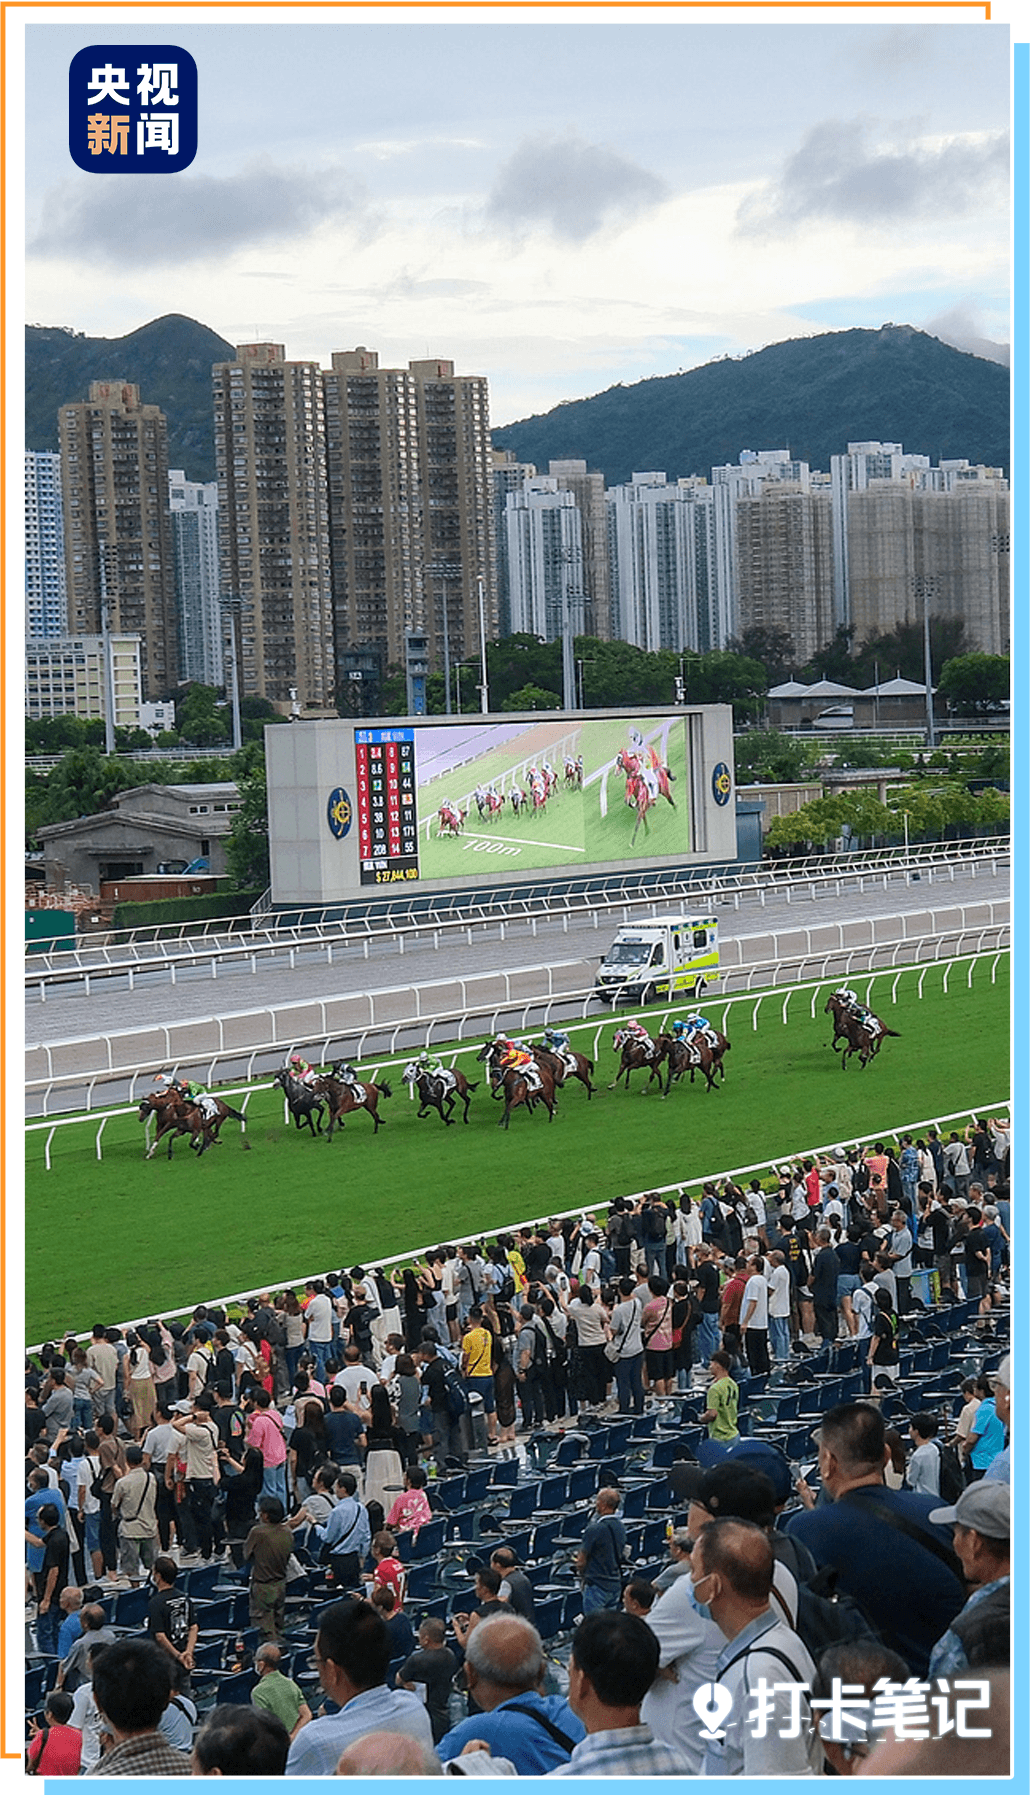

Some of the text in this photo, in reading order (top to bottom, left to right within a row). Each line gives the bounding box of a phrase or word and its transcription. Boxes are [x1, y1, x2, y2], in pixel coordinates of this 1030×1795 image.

[359, 748, 364, 759] 1
[359, 764, 365, 775] 2
[359, 780, 366, 792] 3
[402, 777, 412, 789] 44
[361, 796, 367, 808] 4
[390, 795, 398, 806] 11
[361, 813, 367, 824] 5
[389, 810, 399, 822] 12
[404, 809, 412, 821] 11
[362, 829, 368, 841] 6
[391, 826, 400, 838] 13
[363, 845, 369, 857] 7
[391, 842, 400, 854] 14
[404, 841, 414, 853] 55
[462, 838, 522, 857] 100m
